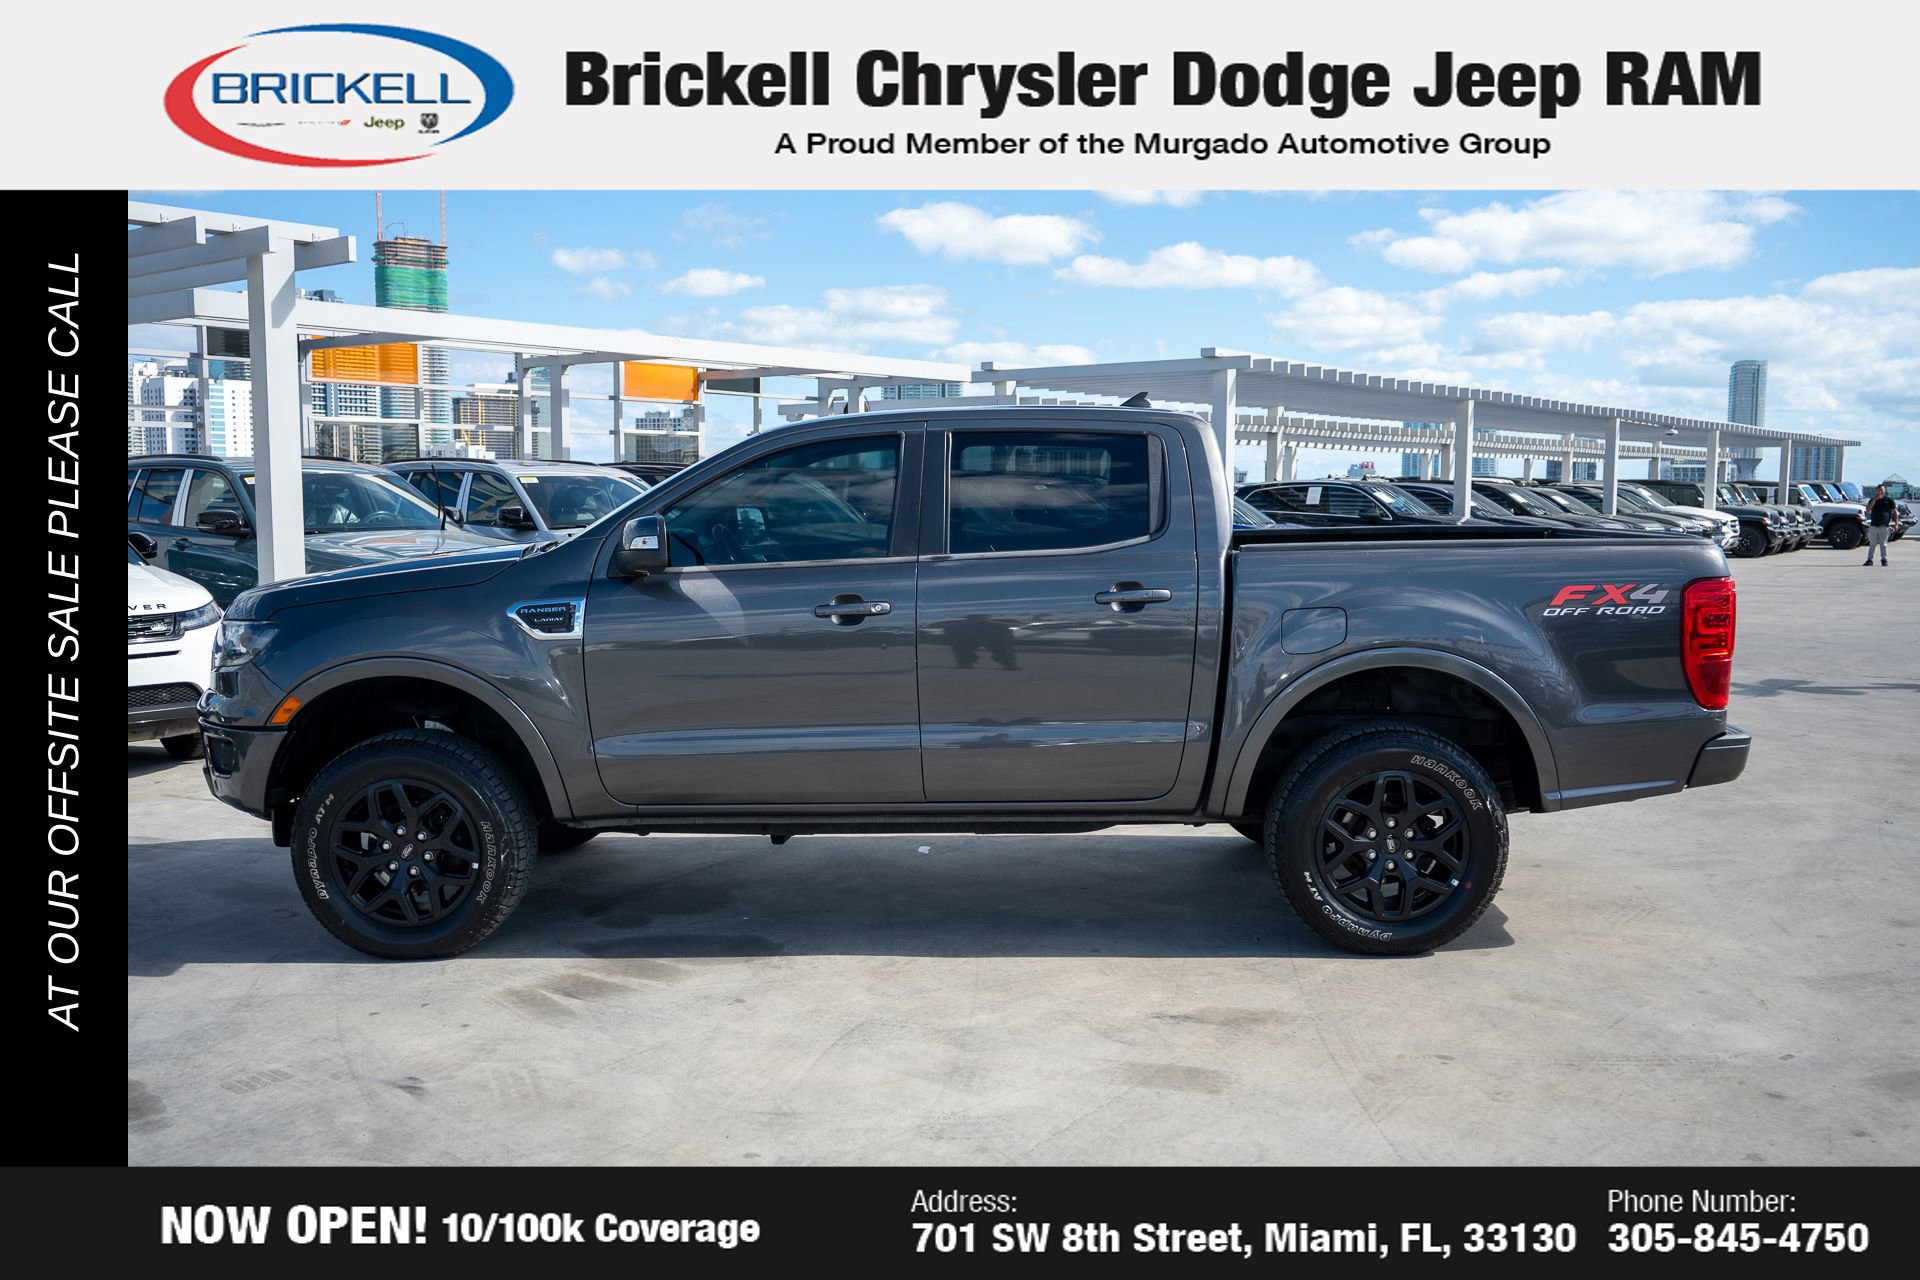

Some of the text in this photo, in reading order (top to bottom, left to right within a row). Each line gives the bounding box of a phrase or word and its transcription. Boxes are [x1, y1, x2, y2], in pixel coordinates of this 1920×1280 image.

[1549, 583, 1669, 606] FX4
[520, 606, 566, 614] RANGER
[1542, 605, 1666, 616] OFF ROAD
